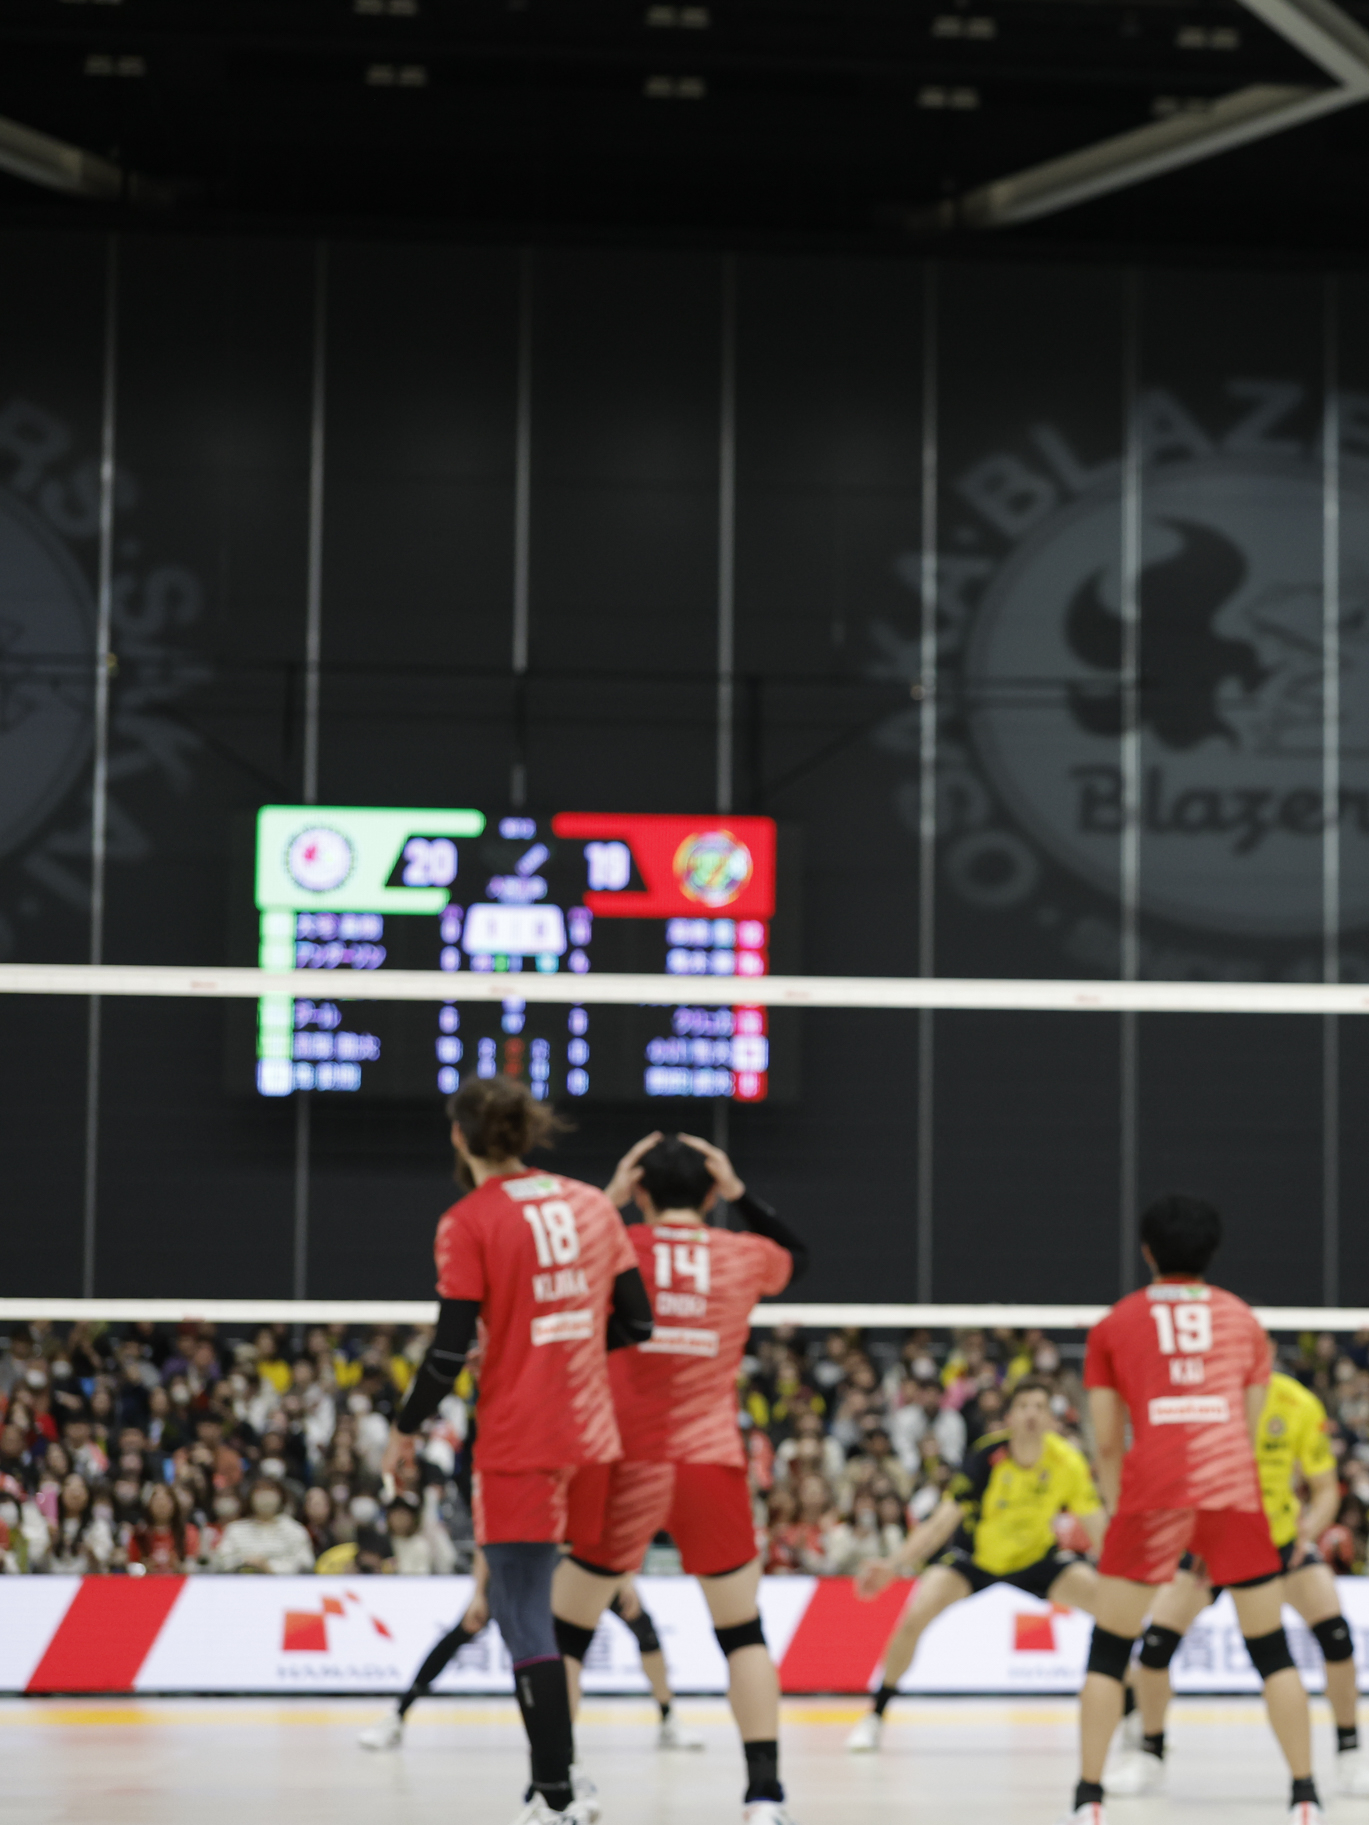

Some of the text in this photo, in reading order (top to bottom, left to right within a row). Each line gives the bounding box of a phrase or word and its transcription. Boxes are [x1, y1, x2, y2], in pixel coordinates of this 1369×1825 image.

[402, 837, 458, 886] 20
[583, 841, 631, 890] 19
[523, 1201, 580, 1268] 18
[652, 1242, 711, 1295] 14
[1150, 1303, 1213, 1355] 19
